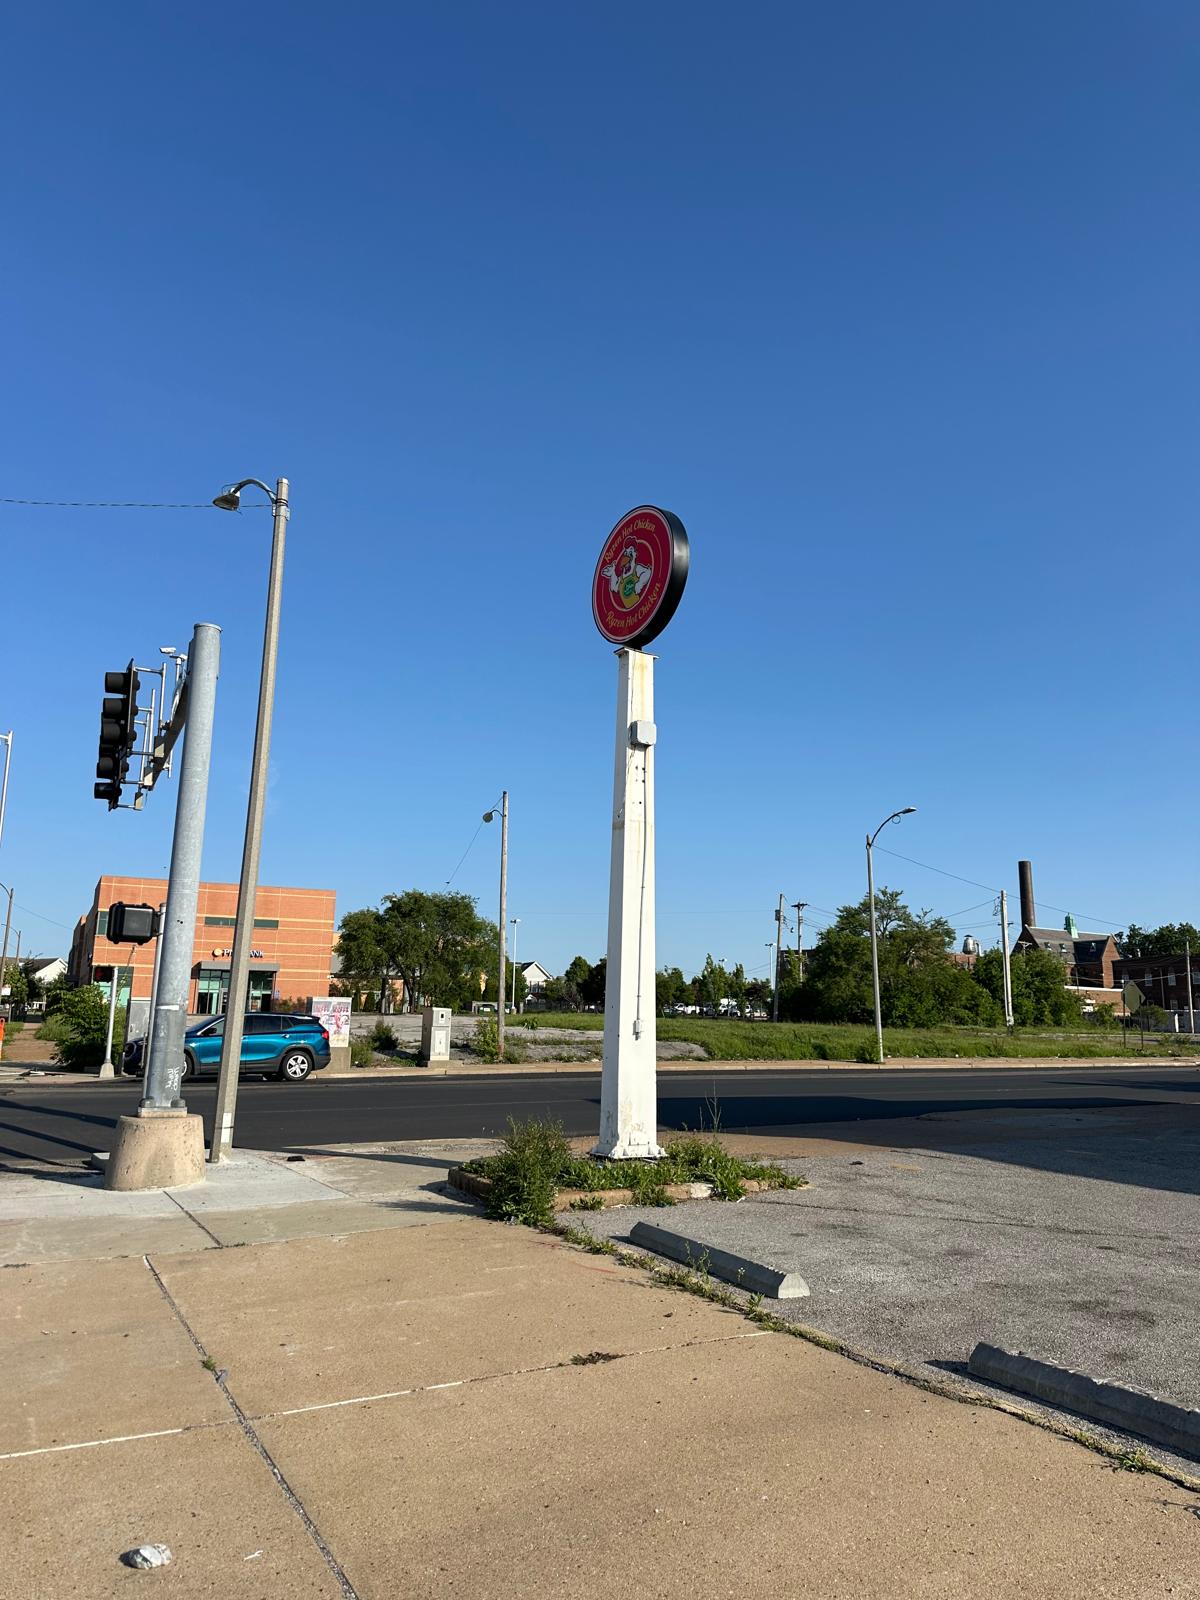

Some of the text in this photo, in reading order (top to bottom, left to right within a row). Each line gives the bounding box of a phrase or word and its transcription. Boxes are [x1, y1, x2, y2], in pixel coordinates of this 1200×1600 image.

[622, 526, 633, 539] Hot
[634, 518, 656, 533] Chicken
[606, 610, 625, 628] Ryzen
[625, 615, 638, 629] Hot
[638, 582, 660, 620] Chicken
